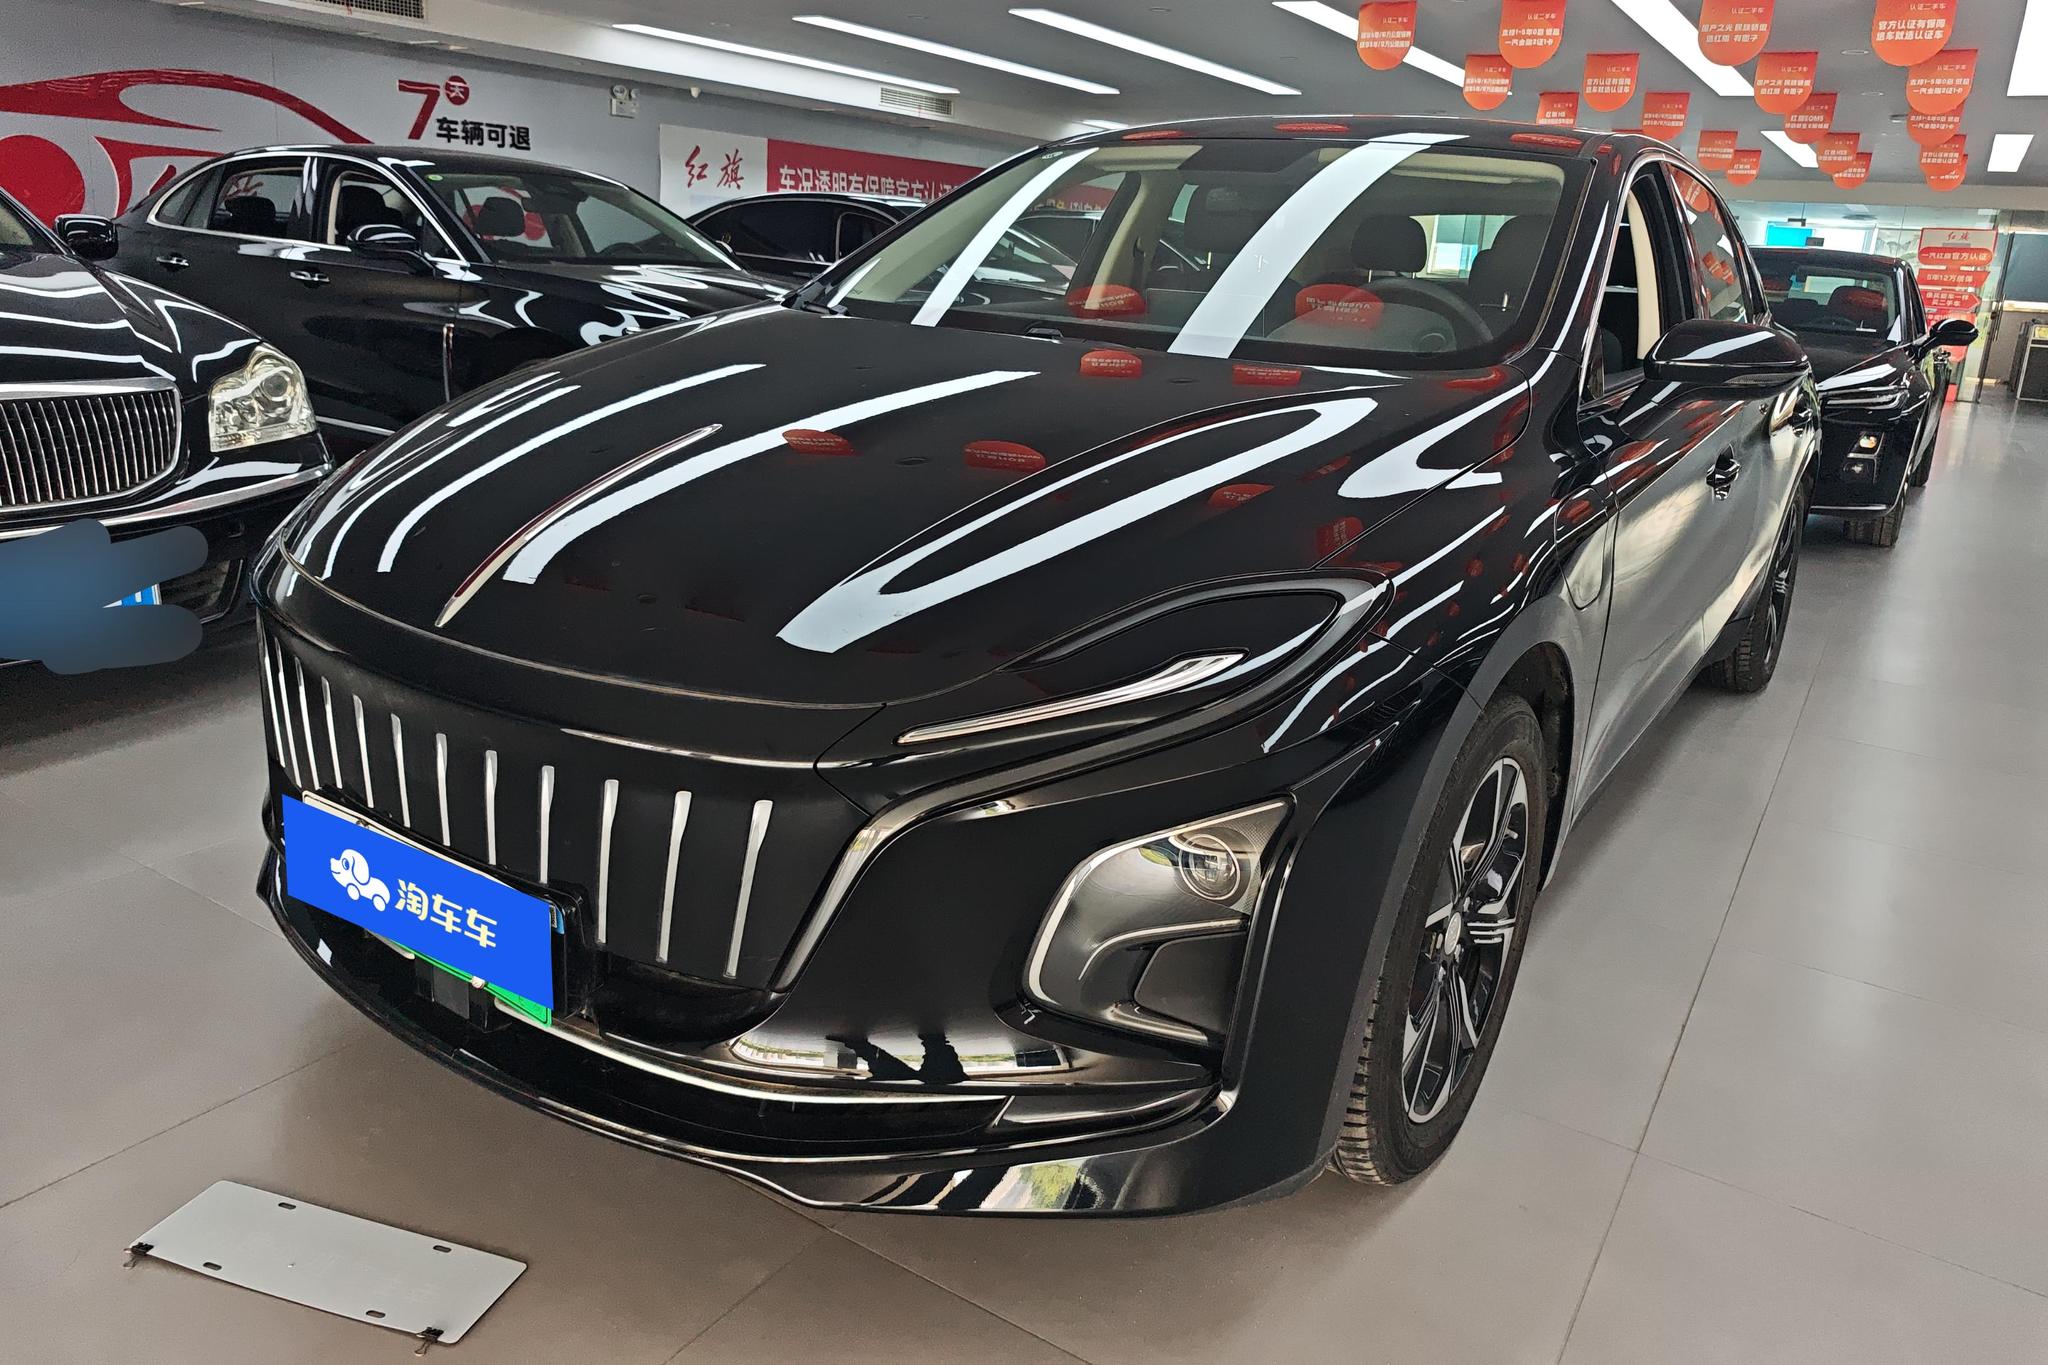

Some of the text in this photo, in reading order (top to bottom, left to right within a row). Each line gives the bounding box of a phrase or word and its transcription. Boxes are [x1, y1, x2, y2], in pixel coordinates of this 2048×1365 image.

[1909, 3, 1946, 11] 认证二手车
[1701, 24, 1733, 32] 国产之光
[1879, 18, 1946, 30] 官方认证有保障
[1876, 30, 1944, 41] 选车就选认证车
[436, 117, 532, 151] 车辆可退
[684, 145, 745, 190] 红旗
